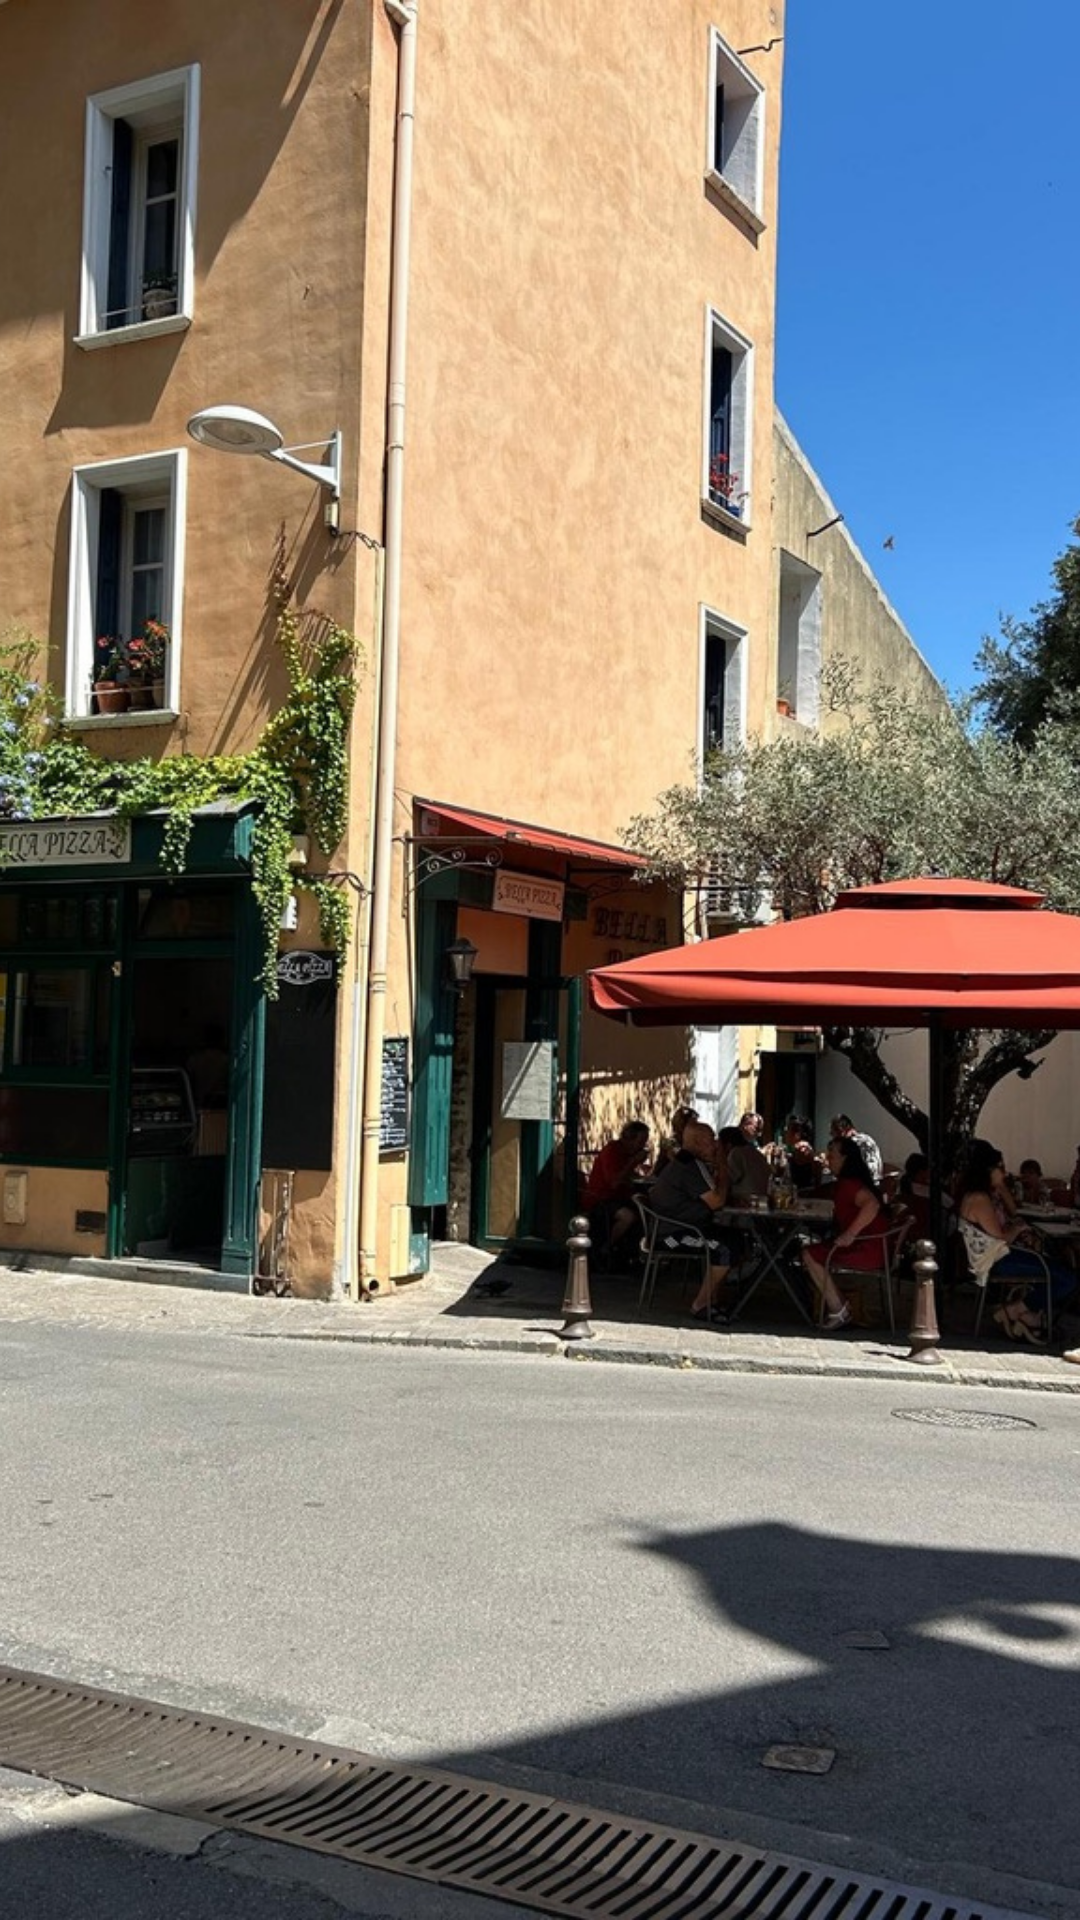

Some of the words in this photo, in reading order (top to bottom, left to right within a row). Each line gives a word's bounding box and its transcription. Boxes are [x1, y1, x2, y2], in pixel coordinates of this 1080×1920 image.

[0, 832, 38, 862] ELLA
[42, 829, 106, 859] PIZZA
[595, 908, 667, 945] BELLA
